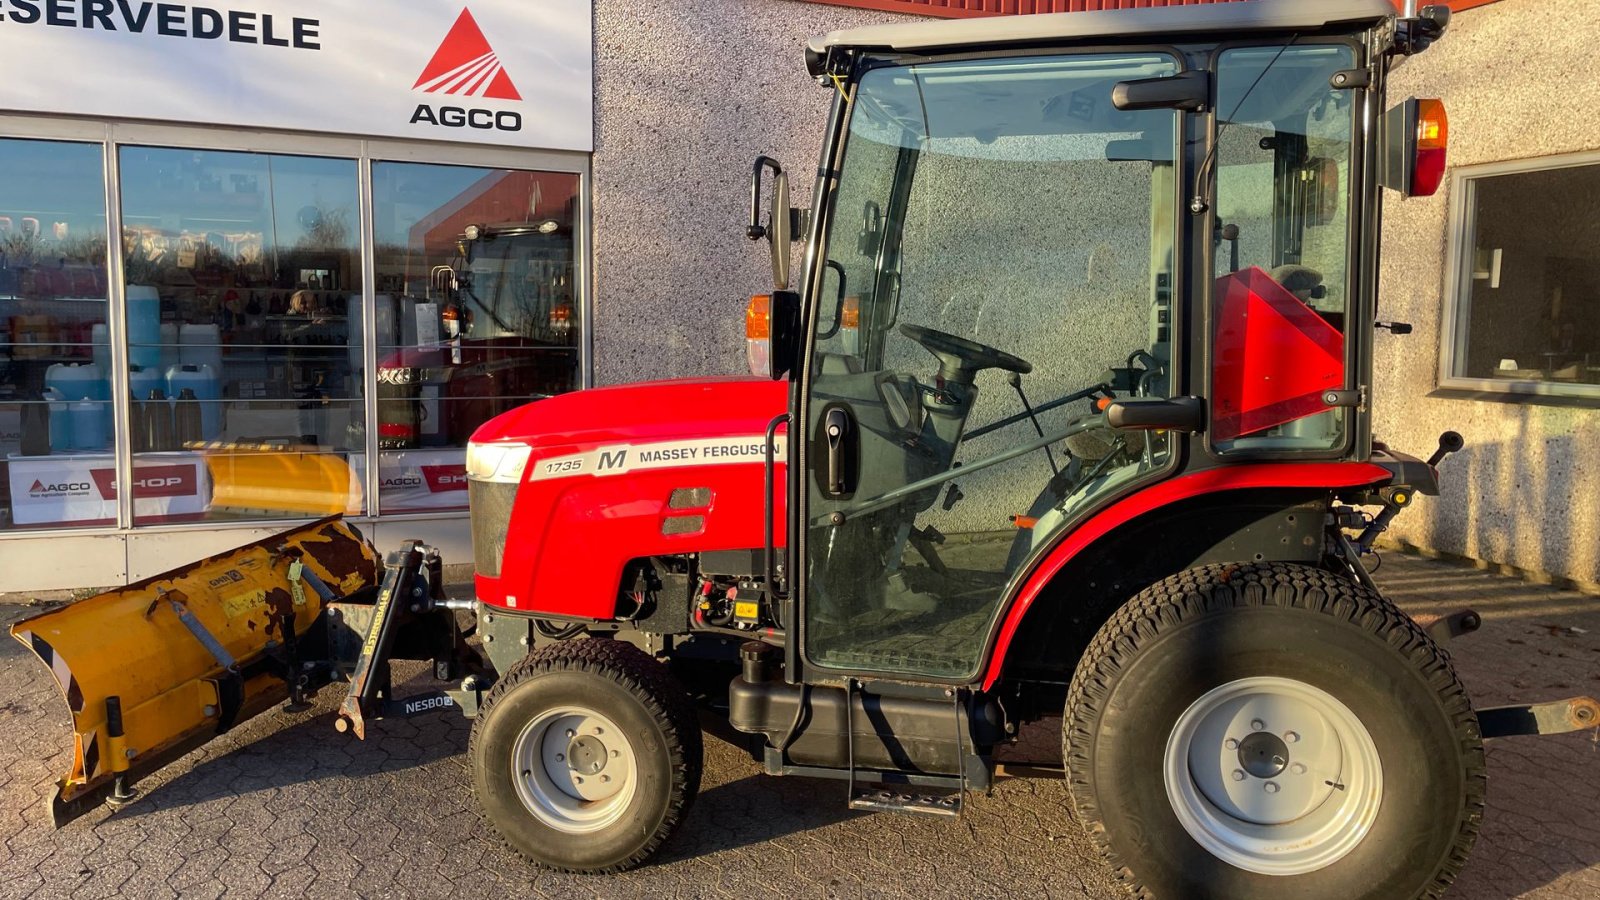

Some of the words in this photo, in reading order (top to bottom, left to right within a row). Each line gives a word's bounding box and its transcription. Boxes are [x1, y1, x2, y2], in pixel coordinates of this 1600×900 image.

[0, 0, 321, 51] SERVEDELE
[409, 104, 522, 132] AGCO
[546, 460, 583, 473] 1735
[597, 450, 628, 470] M
[640, 448, 698, 462] MASSEY
[47, 482, 91, 491] AGCO
[385, 478, 422, 486] AGCO
